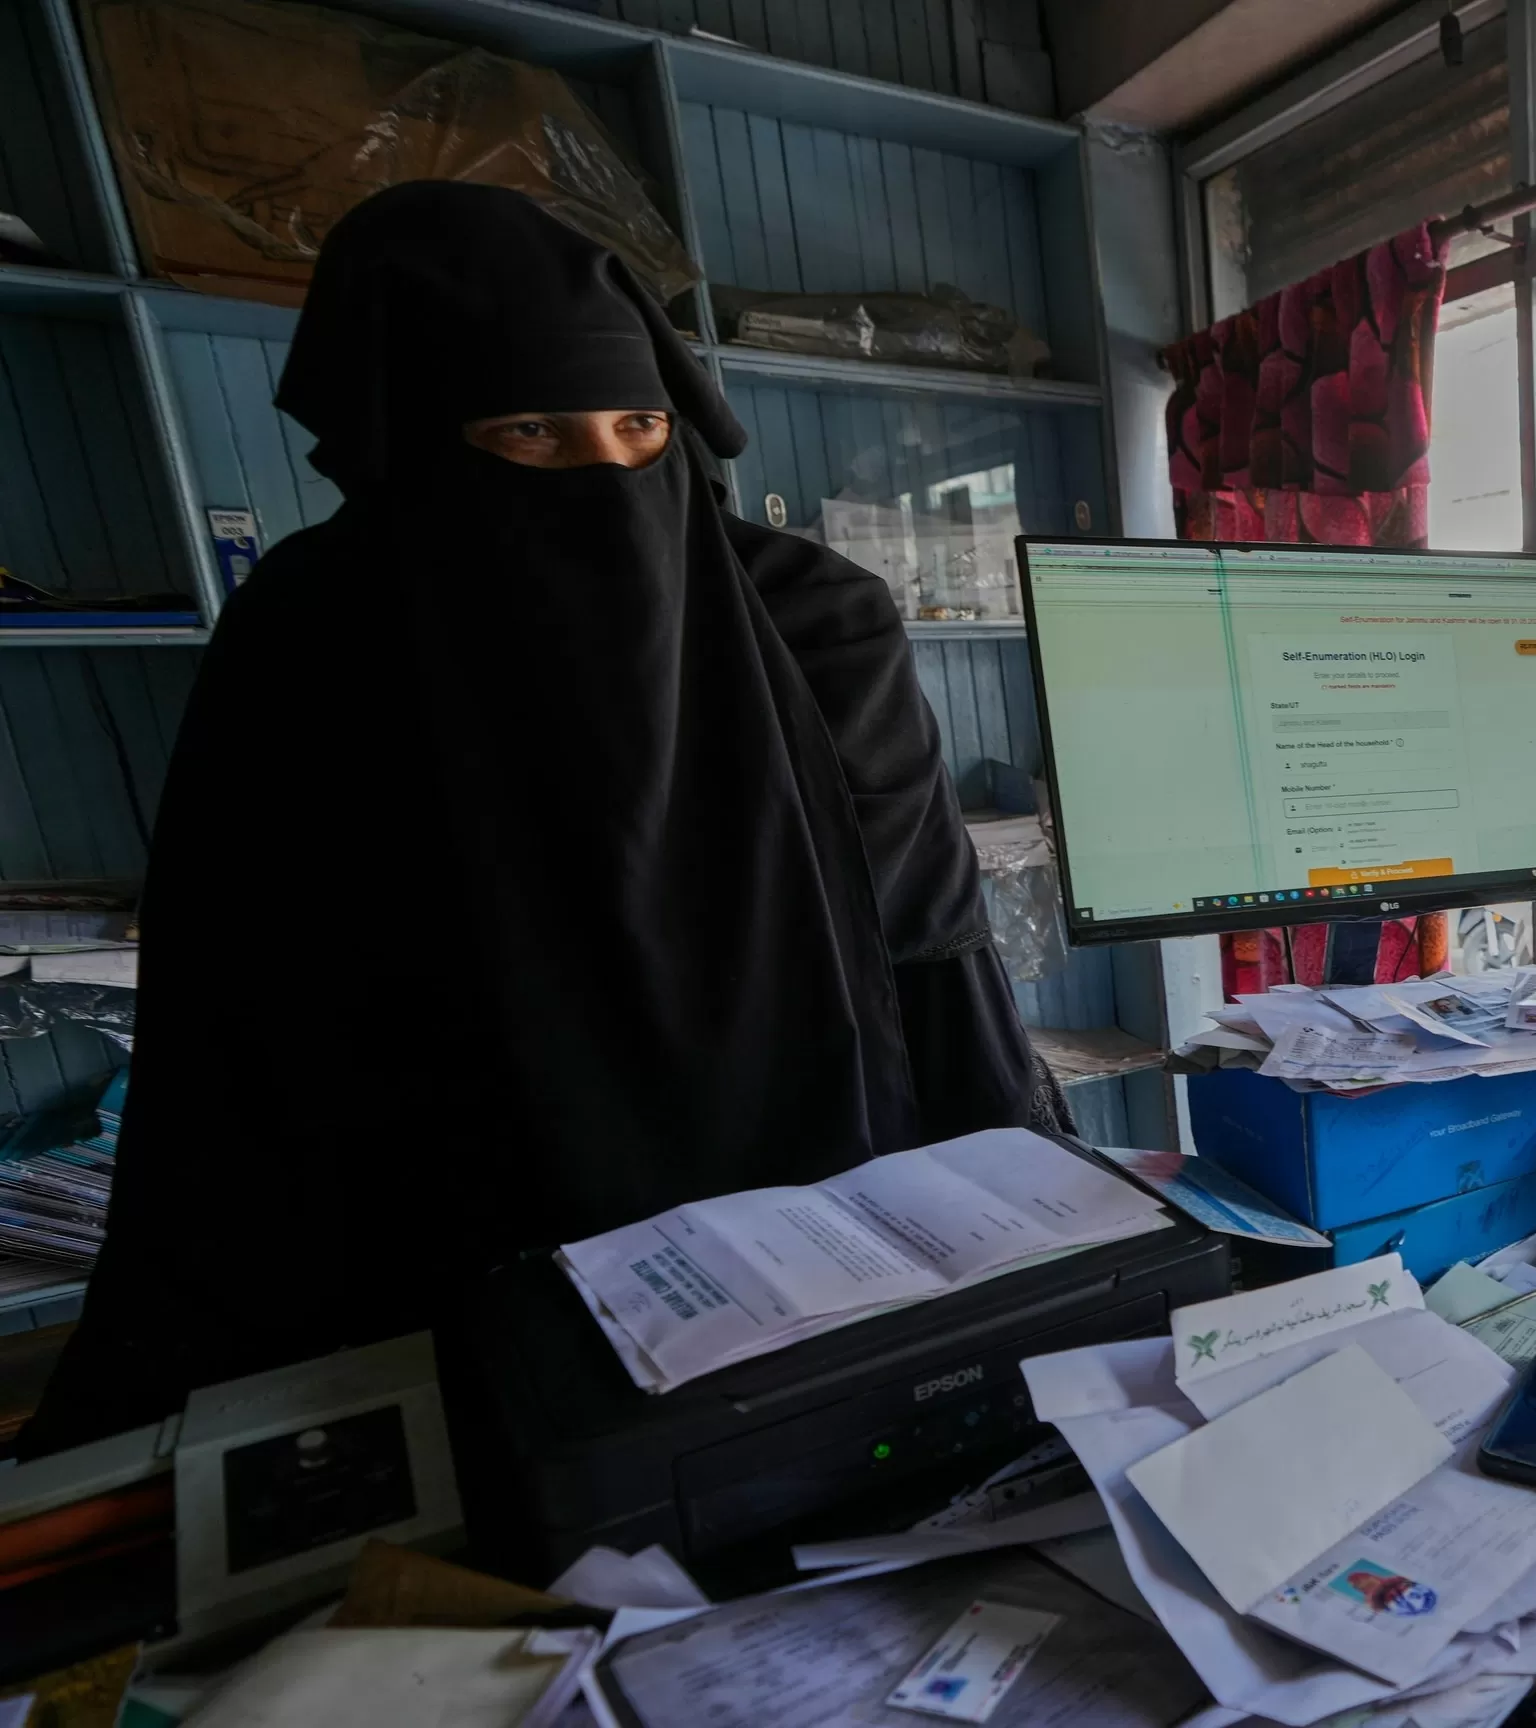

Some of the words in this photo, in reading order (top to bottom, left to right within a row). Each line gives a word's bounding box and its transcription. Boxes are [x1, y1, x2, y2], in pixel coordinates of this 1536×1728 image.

[1282, 651, 1367, 662] Self-Enumeration
[1369, 651, 1397, 663] (HLO)
[1399, 651, 1426, 663] Login
[1346, 671, 1366, 679] details
[1270, 702, 1300, 710] State/UT
[1275, 742, 1295, 750] Name
[1317, 741, 1335, 749] Head
[1343, 740, 1355, 748] the
[1281, 785, 1304, 793] Mobile
[1305, 783, 1332, 792] Number
[1286, 827, 1306, 836] Email
[1389, 902, 1400, 910] LG
[1430, 1128, 1446, 1138] Your
[1447, 1115, 1490, 1134] Broadband
[913, 1363, 985, 1402] EPSON
